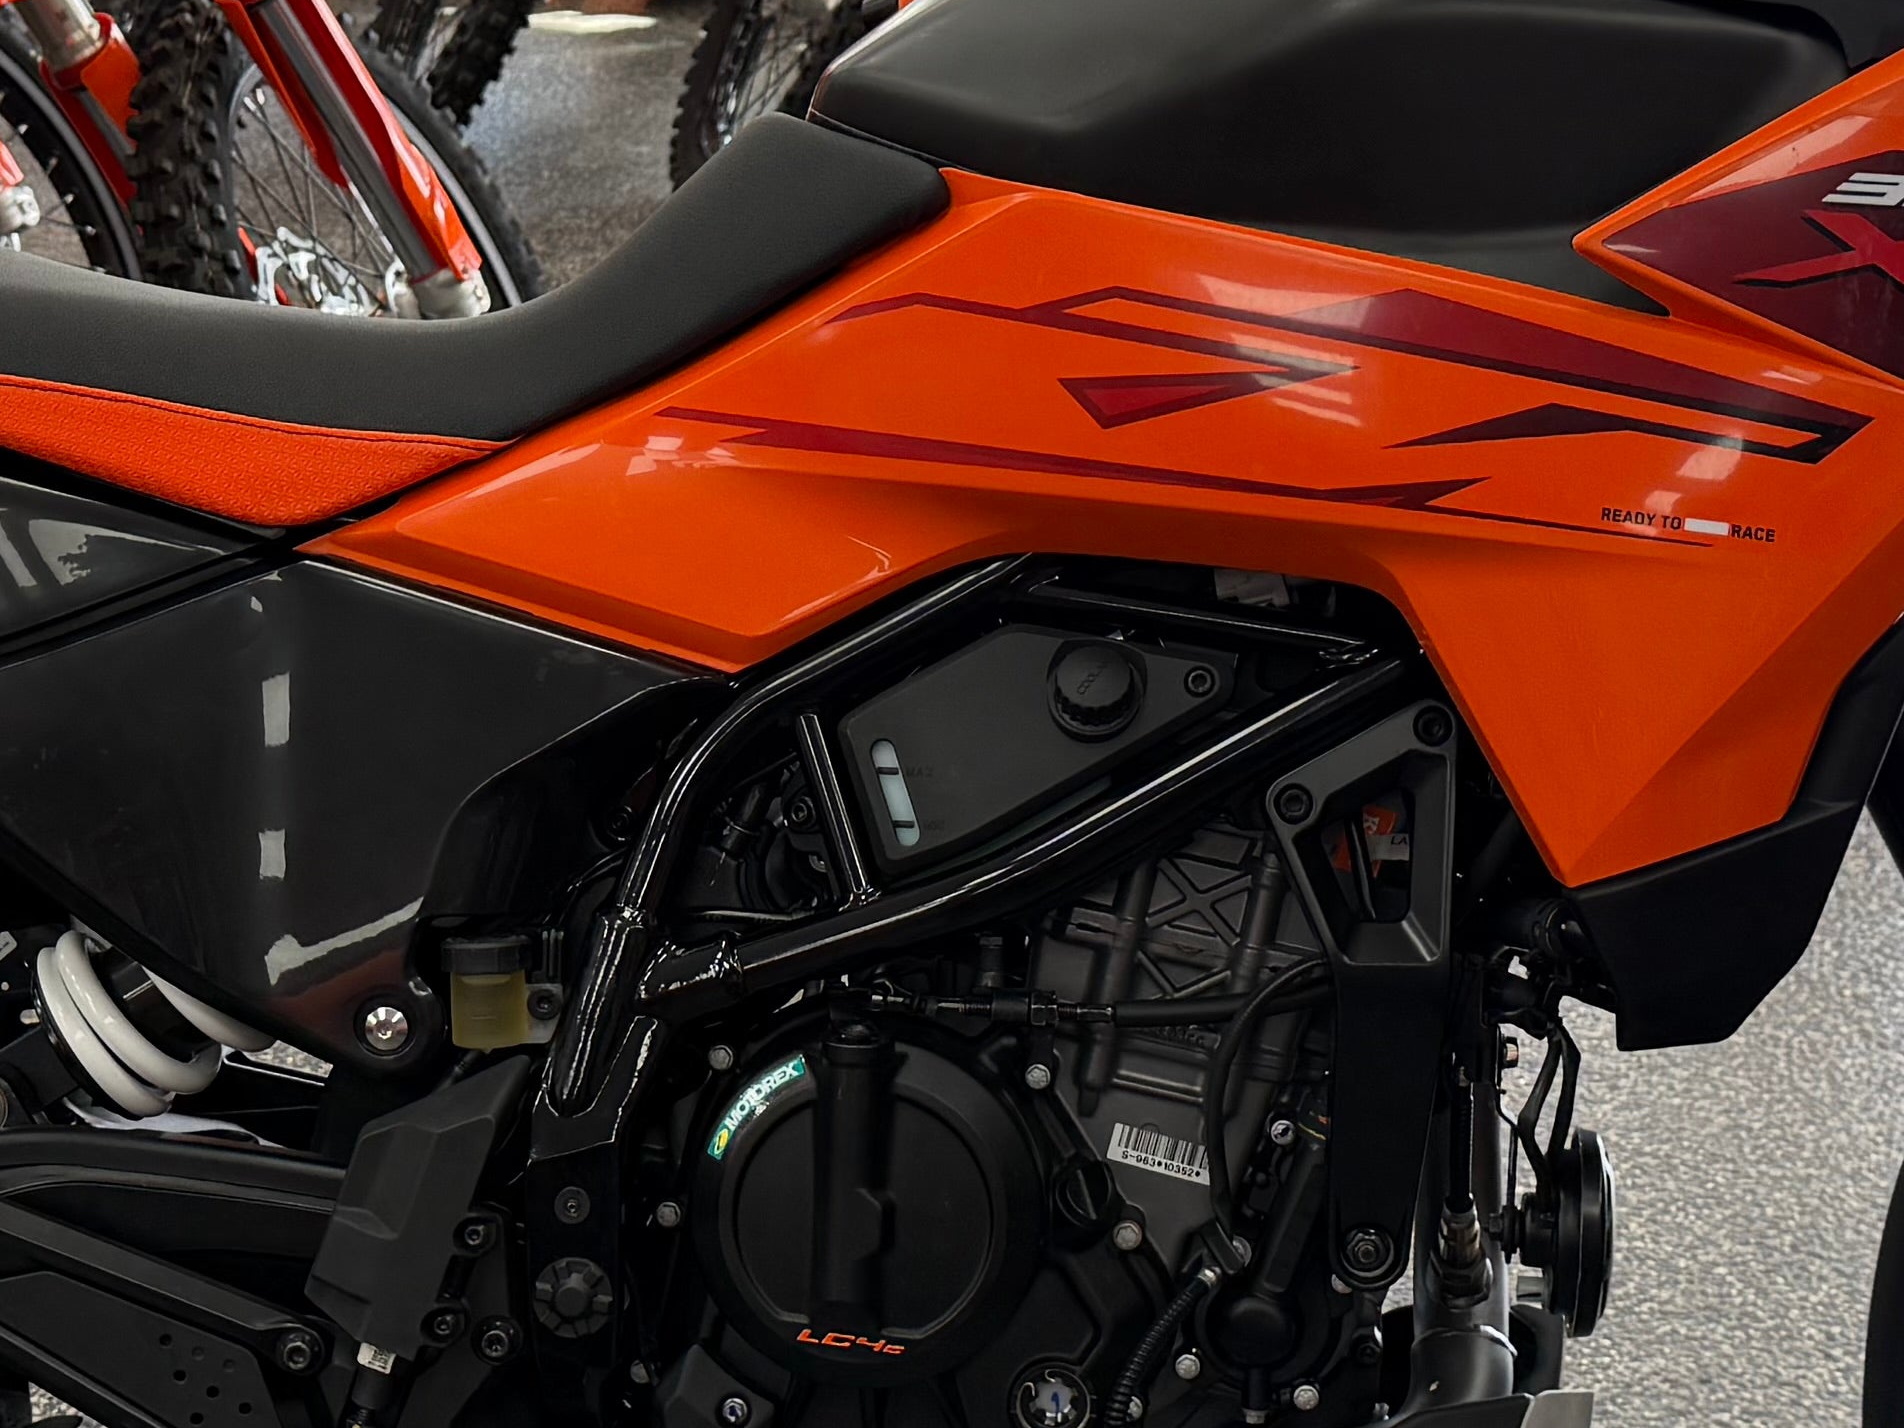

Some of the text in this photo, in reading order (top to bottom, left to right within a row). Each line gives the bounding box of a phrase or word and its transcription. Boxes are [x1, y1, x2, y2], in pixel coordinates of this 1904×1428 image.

[1601, 506, 1776, 543] READY TO RACE
[724, 1059, 802, 1132] MOTOREX
